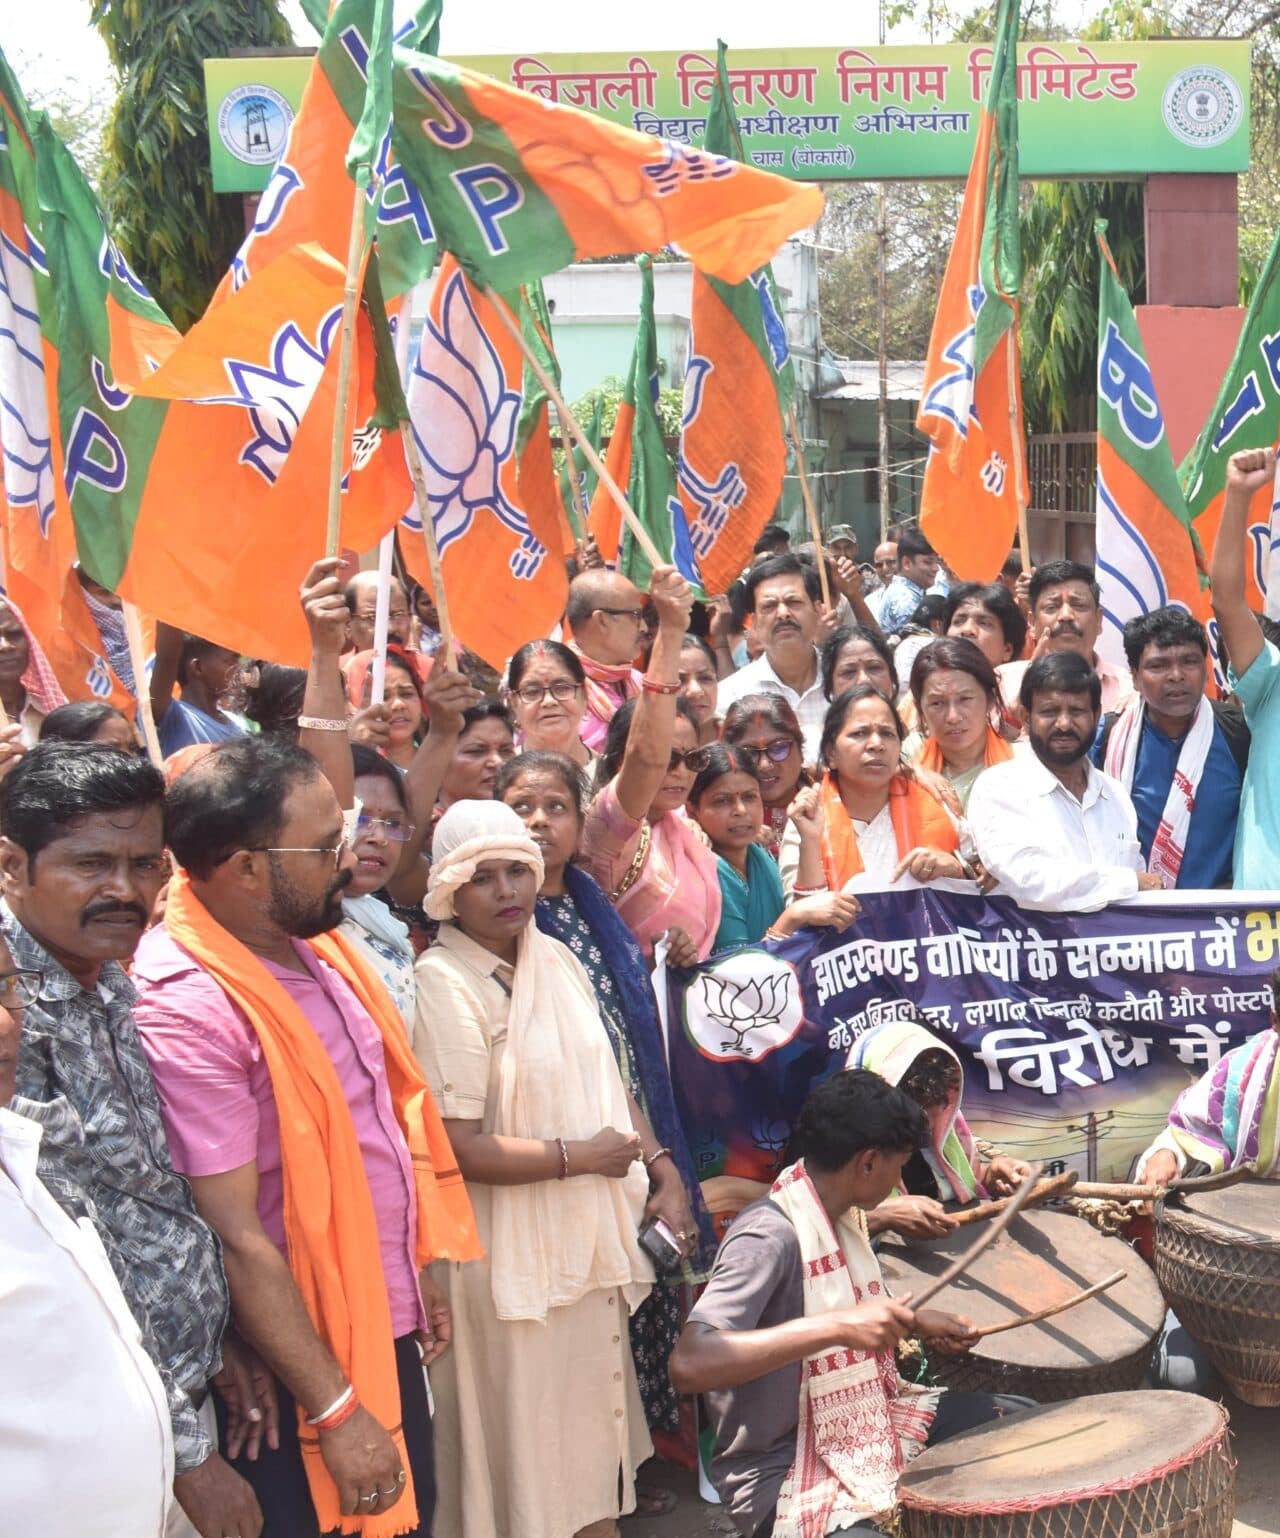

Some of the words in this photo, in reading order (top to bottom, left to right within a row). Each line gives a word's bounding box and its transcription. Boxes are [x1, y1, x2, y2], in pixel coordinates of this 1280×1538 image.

[512, 57, 657, 109] बिजली
[837, 50, 949, 102] निगम
[967, 47, 1138, 101] िमिटेड
[854, 106, 971, 134] अभियंता
[752, 151, 784, 168] चास
[791, 146, 856, 170] (बोकारो)
[1023, 928, 1058, 981] के
[1063, 931, 1196, 979] सम्मान
[1200, 917, 1238, 969] में
[1096, 990, 1164, 1022] कटौती
[1169, 986, 1208, 1018] और
[1211, 984, 1275, 1014] पोस्टपे
[973, 1018, 1153, 1096] विरोध
